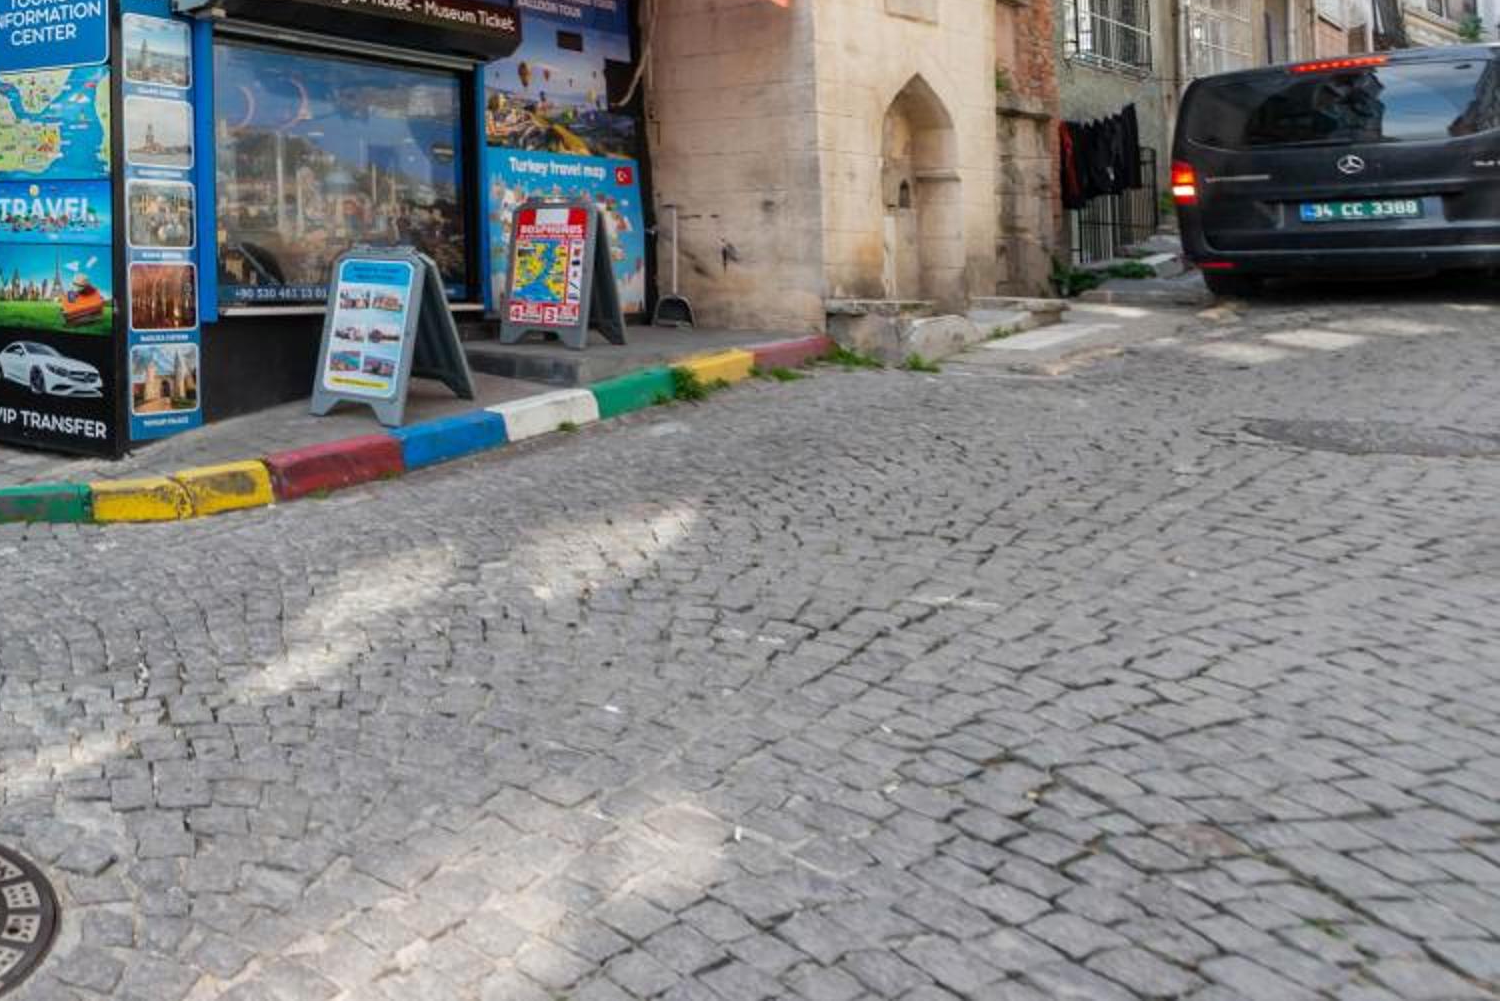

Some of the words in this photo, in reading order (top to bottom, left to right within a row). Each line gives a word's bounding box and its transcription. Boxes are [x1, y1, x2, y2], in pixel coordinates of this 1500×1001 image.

[425, 0, 477, 24] Museum
[478, 9, 516, 32] Ticket
[11, 22, 77, 46] CENTER
[509, 157, 549, 177] Turkey
[1314, 203, 1333, 218] 34
[1341, 202, 1363, 216] CC
[19, 410, 107, 438] TRANSFER
